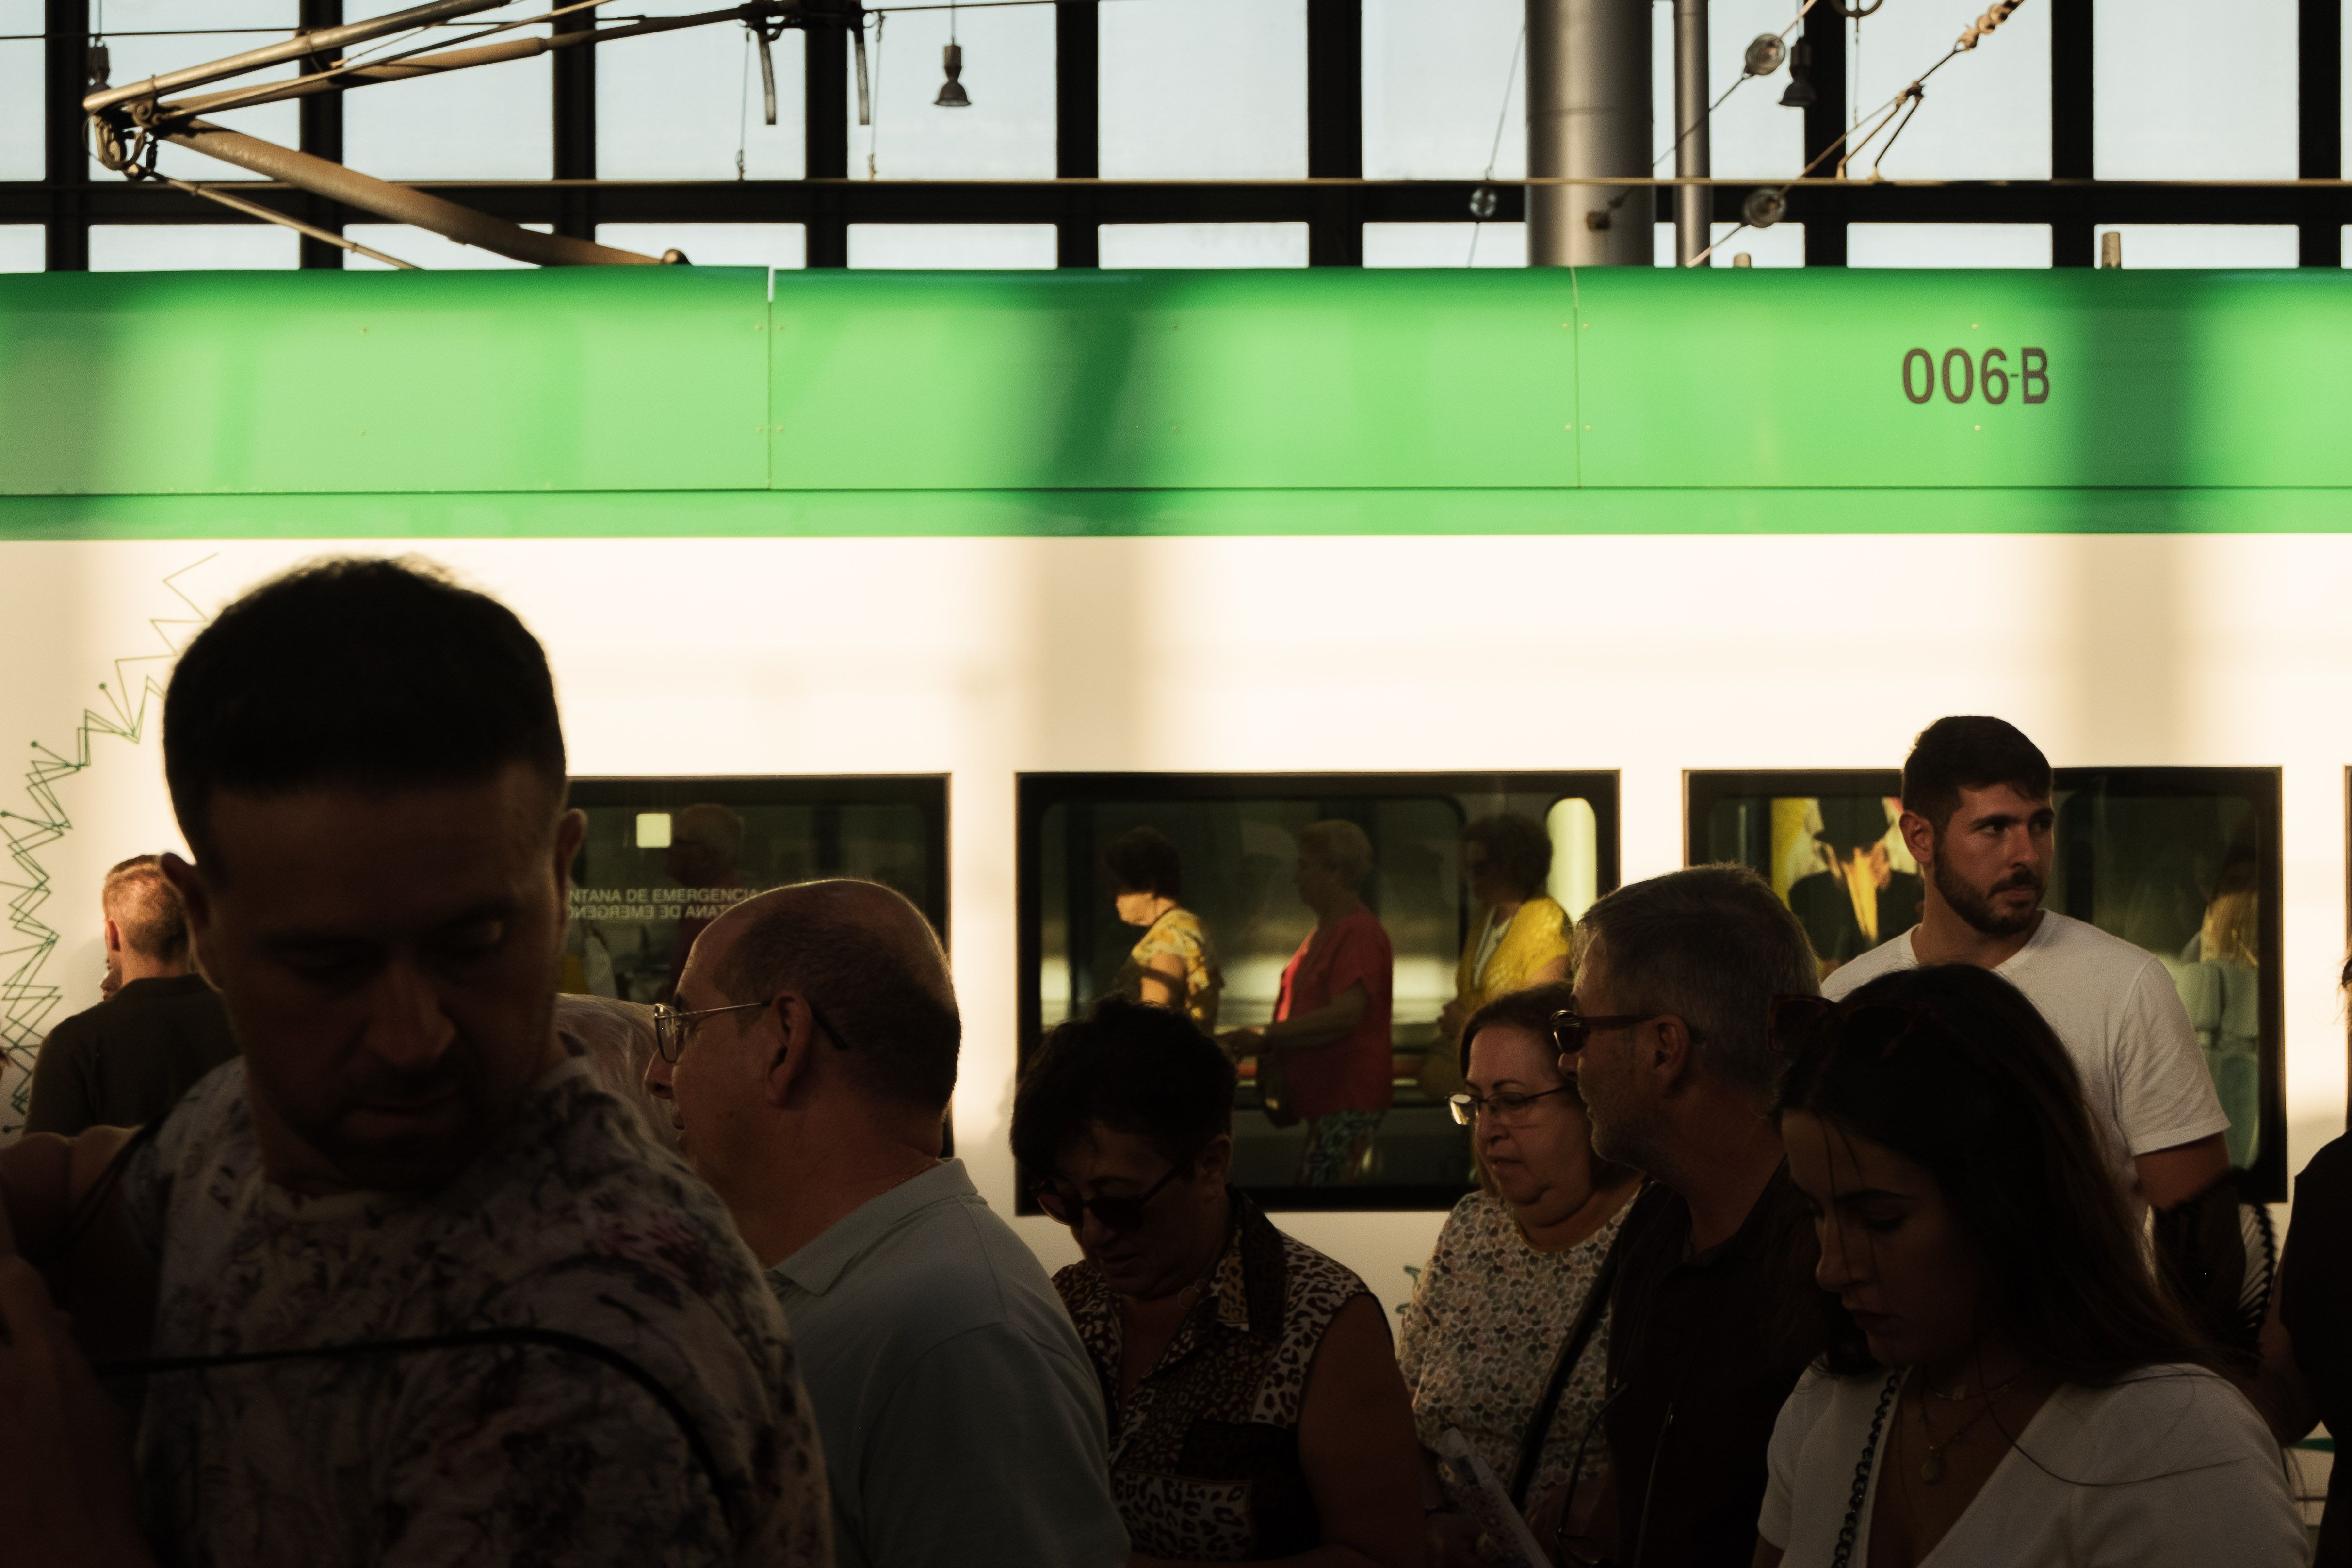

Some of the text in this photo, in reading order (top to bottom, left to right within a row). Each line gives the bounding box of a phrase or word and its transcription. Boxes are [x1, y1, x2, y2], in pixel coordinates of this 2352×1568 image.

[1903, 347, 2049, 404] 006-B
[569, 889, 621, 902] NTANA
[625, 889, 648, 902] DE
